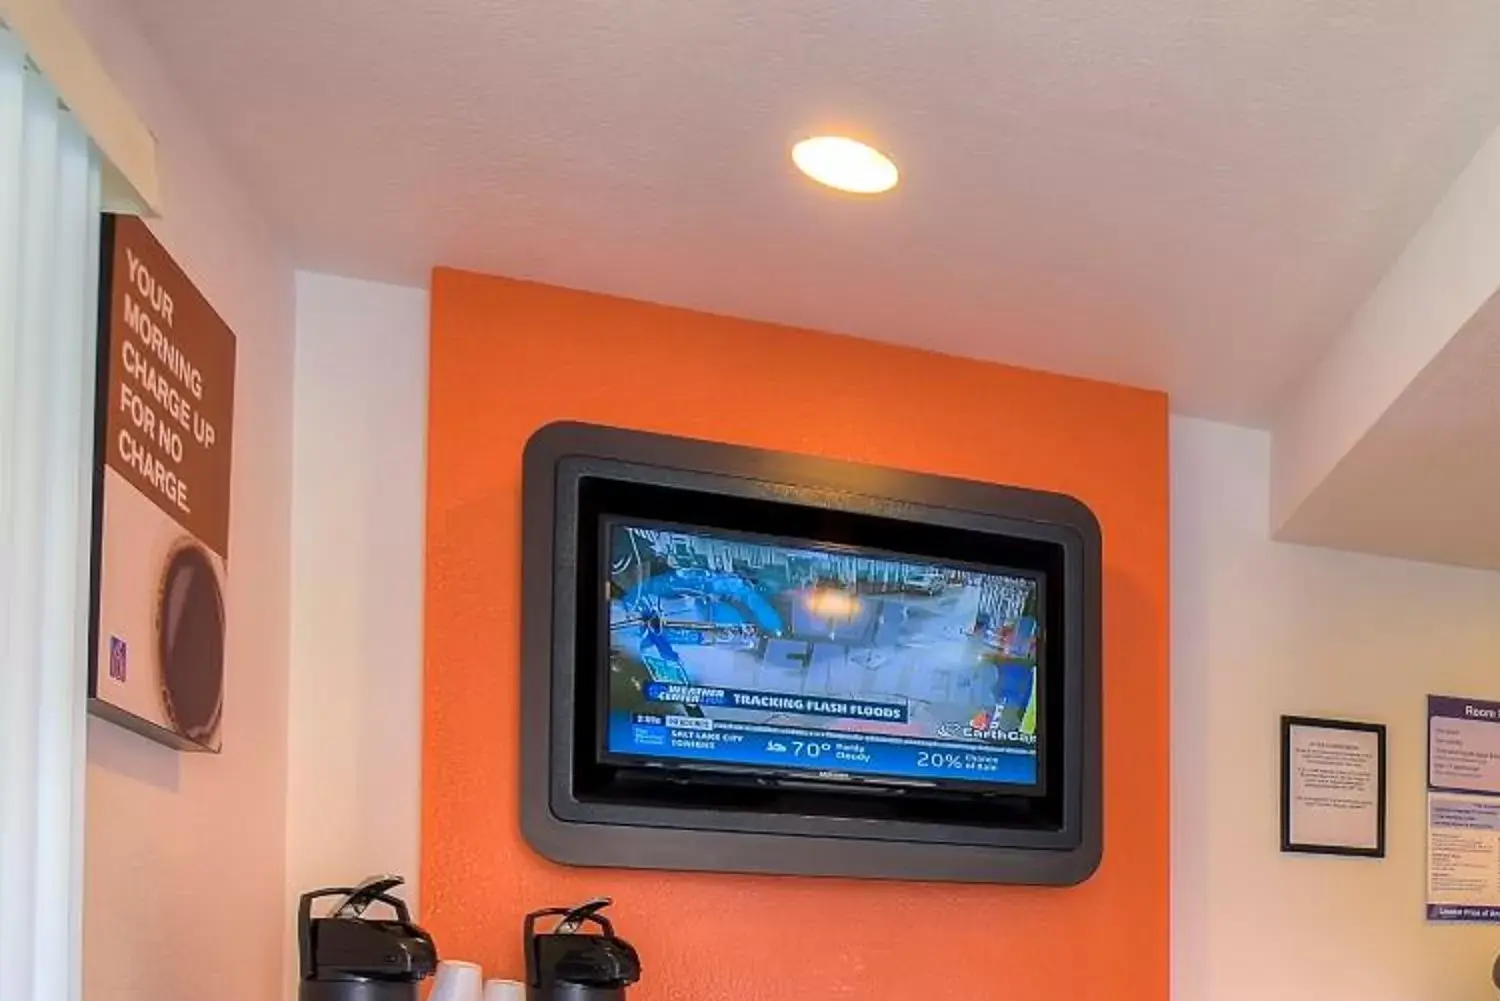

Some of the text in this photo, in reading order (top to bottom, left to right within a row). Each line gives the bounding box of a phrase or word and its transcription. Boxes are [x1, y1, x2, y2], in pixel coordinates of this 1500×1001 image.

[126, 248, 174, 328] YOUR
[124, 293, 202, 401] MORNING
[120, 383, 183, 463] FOR NO
[121, 340, 215, 449] CHARGE UP
[118, 429, 191, 513] CHARGE.
[733, 693, 803, 710] TRACKING
[807, 700, 848, 714] FLASH
[850, 703, 901, 719] FLOODS
[1465, 705, 1496, 718] Room
[916, 751, 963, 770] 20%
